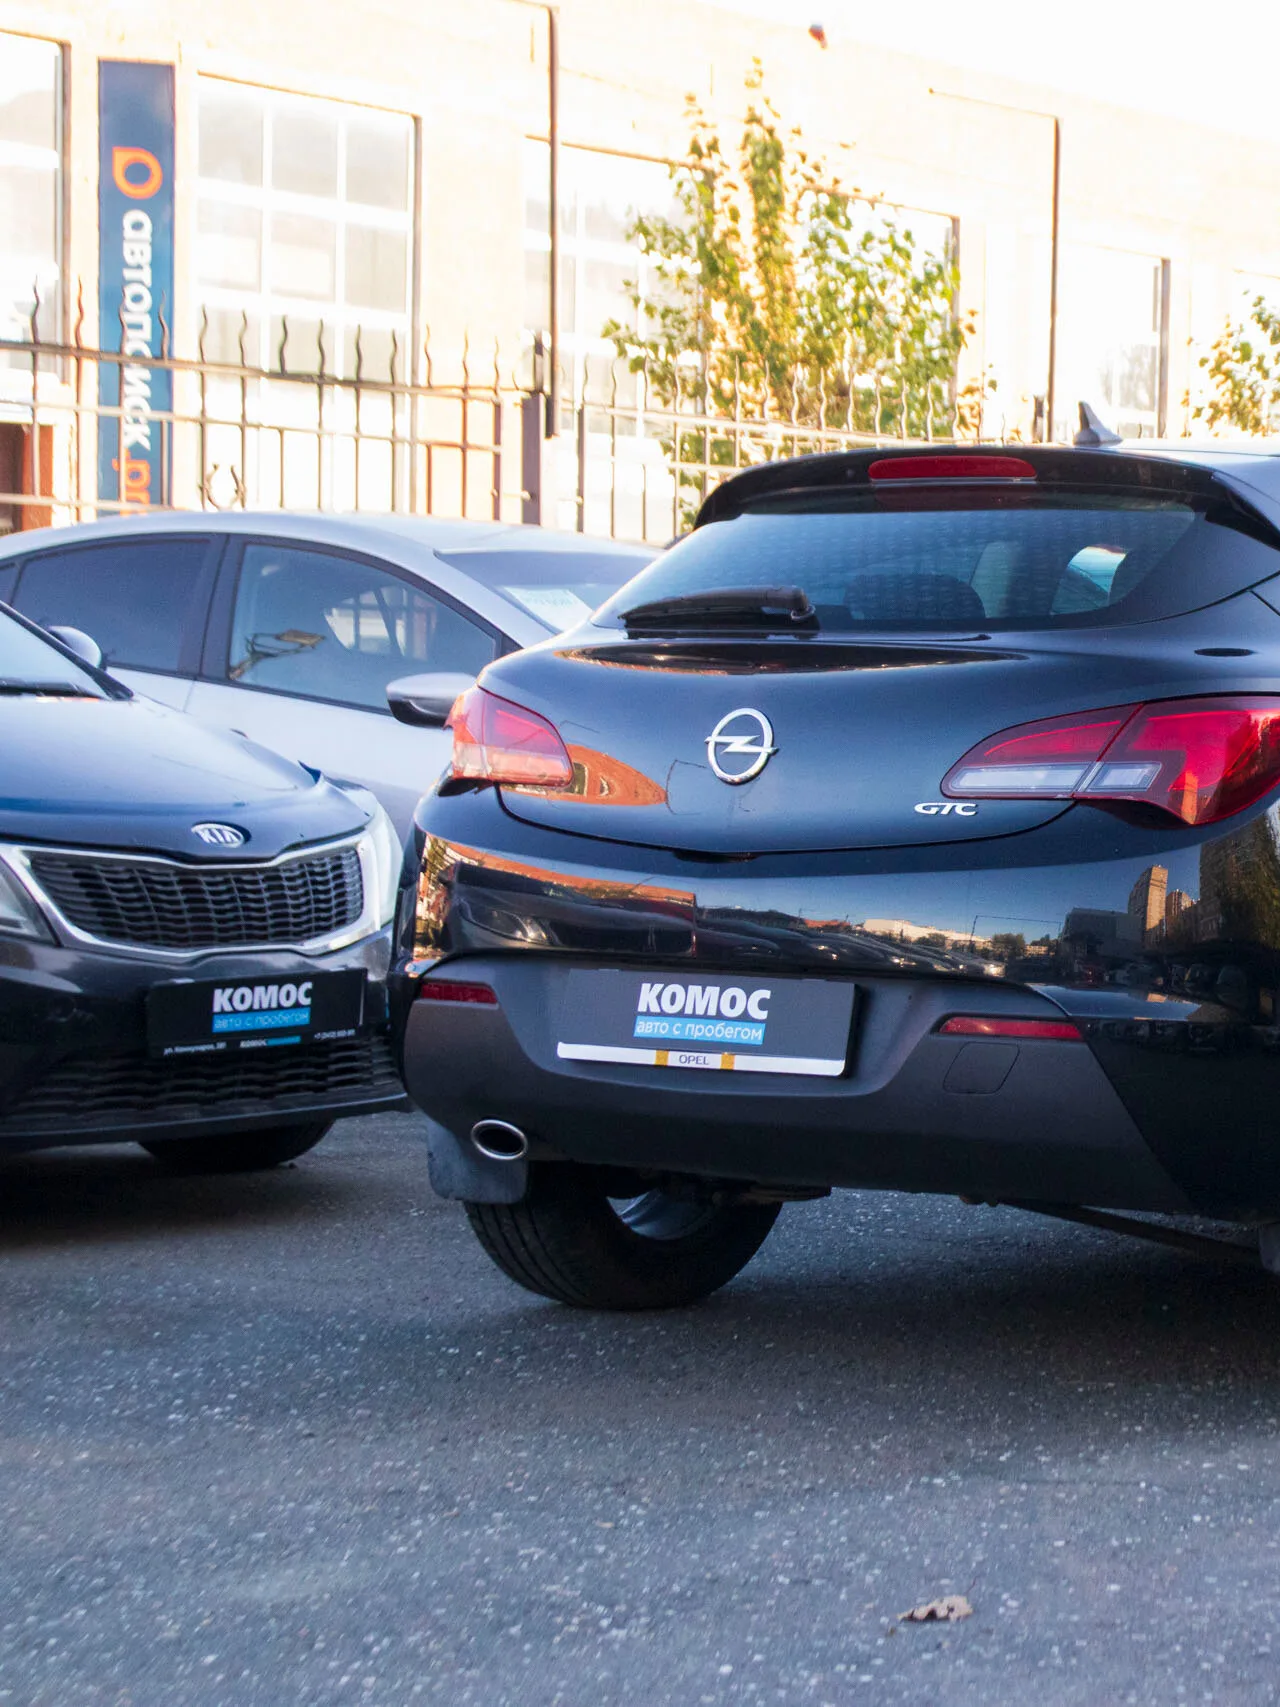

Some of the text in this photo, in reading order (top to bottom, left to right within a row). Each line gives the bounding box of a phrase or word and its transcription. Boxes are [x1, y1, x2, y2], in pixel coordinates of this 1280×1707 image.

[914, 802, 977, 817] GTC
[193, 825, 242, 846] KIA
[213, 982, 313, 1013] КОМОС
[637, 983, 771, 1020] КОМОС
[636, 1021, 763, 1041] авто с пробегом
[678, 1054, 710, 1066] OPEL
